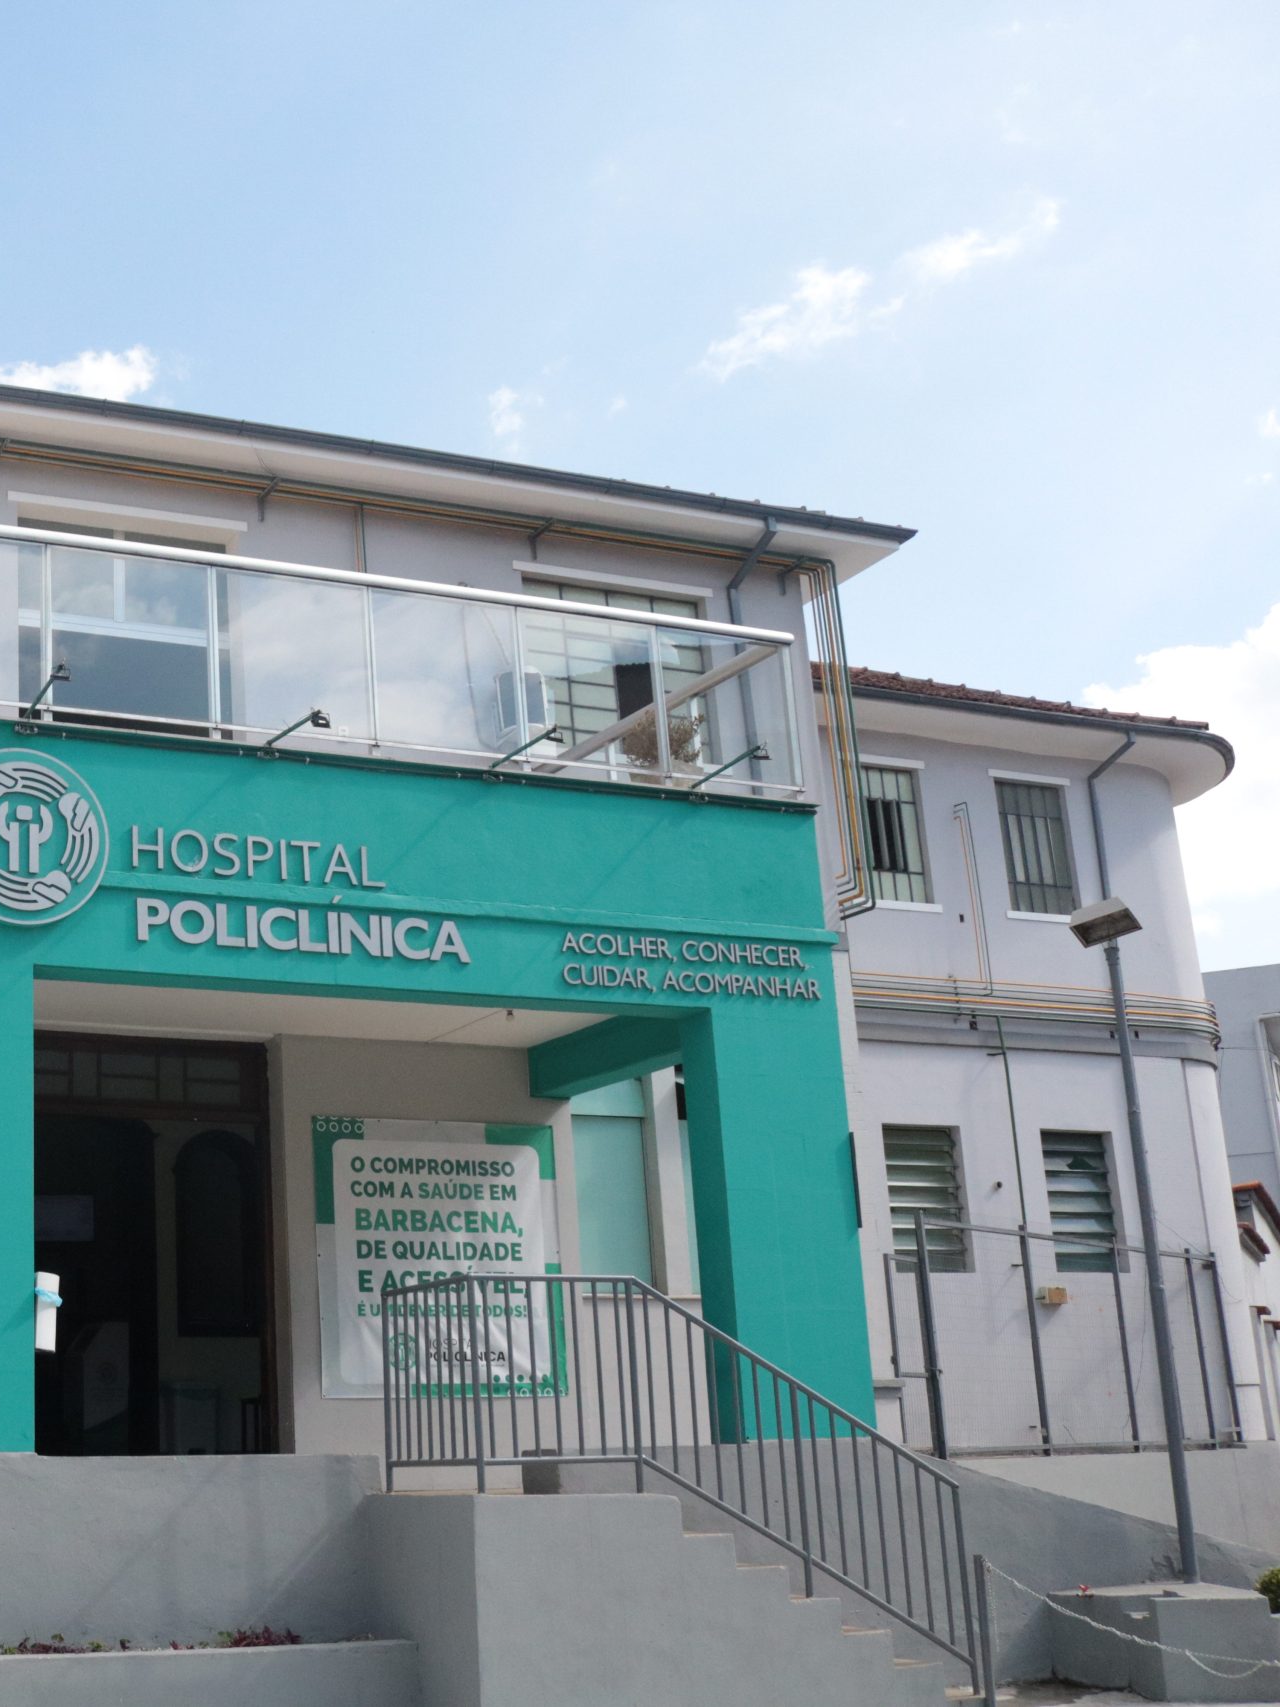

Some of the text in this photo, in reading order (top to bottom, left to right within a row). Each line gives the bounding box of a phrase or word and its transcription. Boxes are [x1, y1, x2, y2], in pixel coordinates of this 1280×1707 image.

[131, 825, 387, 889] HOSPITAL
[136, 895, 472, 964] POLICLÍNICA
[562, 931, 810, 970] ACOLHER, CONHECER,
[563, 963, 821, 1000] CUIDAR, ACOMPANHAR
[351, 1156, 515, 1177] O COMPROMISSO
[350, 1179, 517, 1201] COM A SAÚDE EM
[355, 1208, 524, 1237] BARBACENA,
[356, 1240, 523, 1261] DE QUALIDADE
[358, 1265, 529, 1298] E ACESSVEL,
